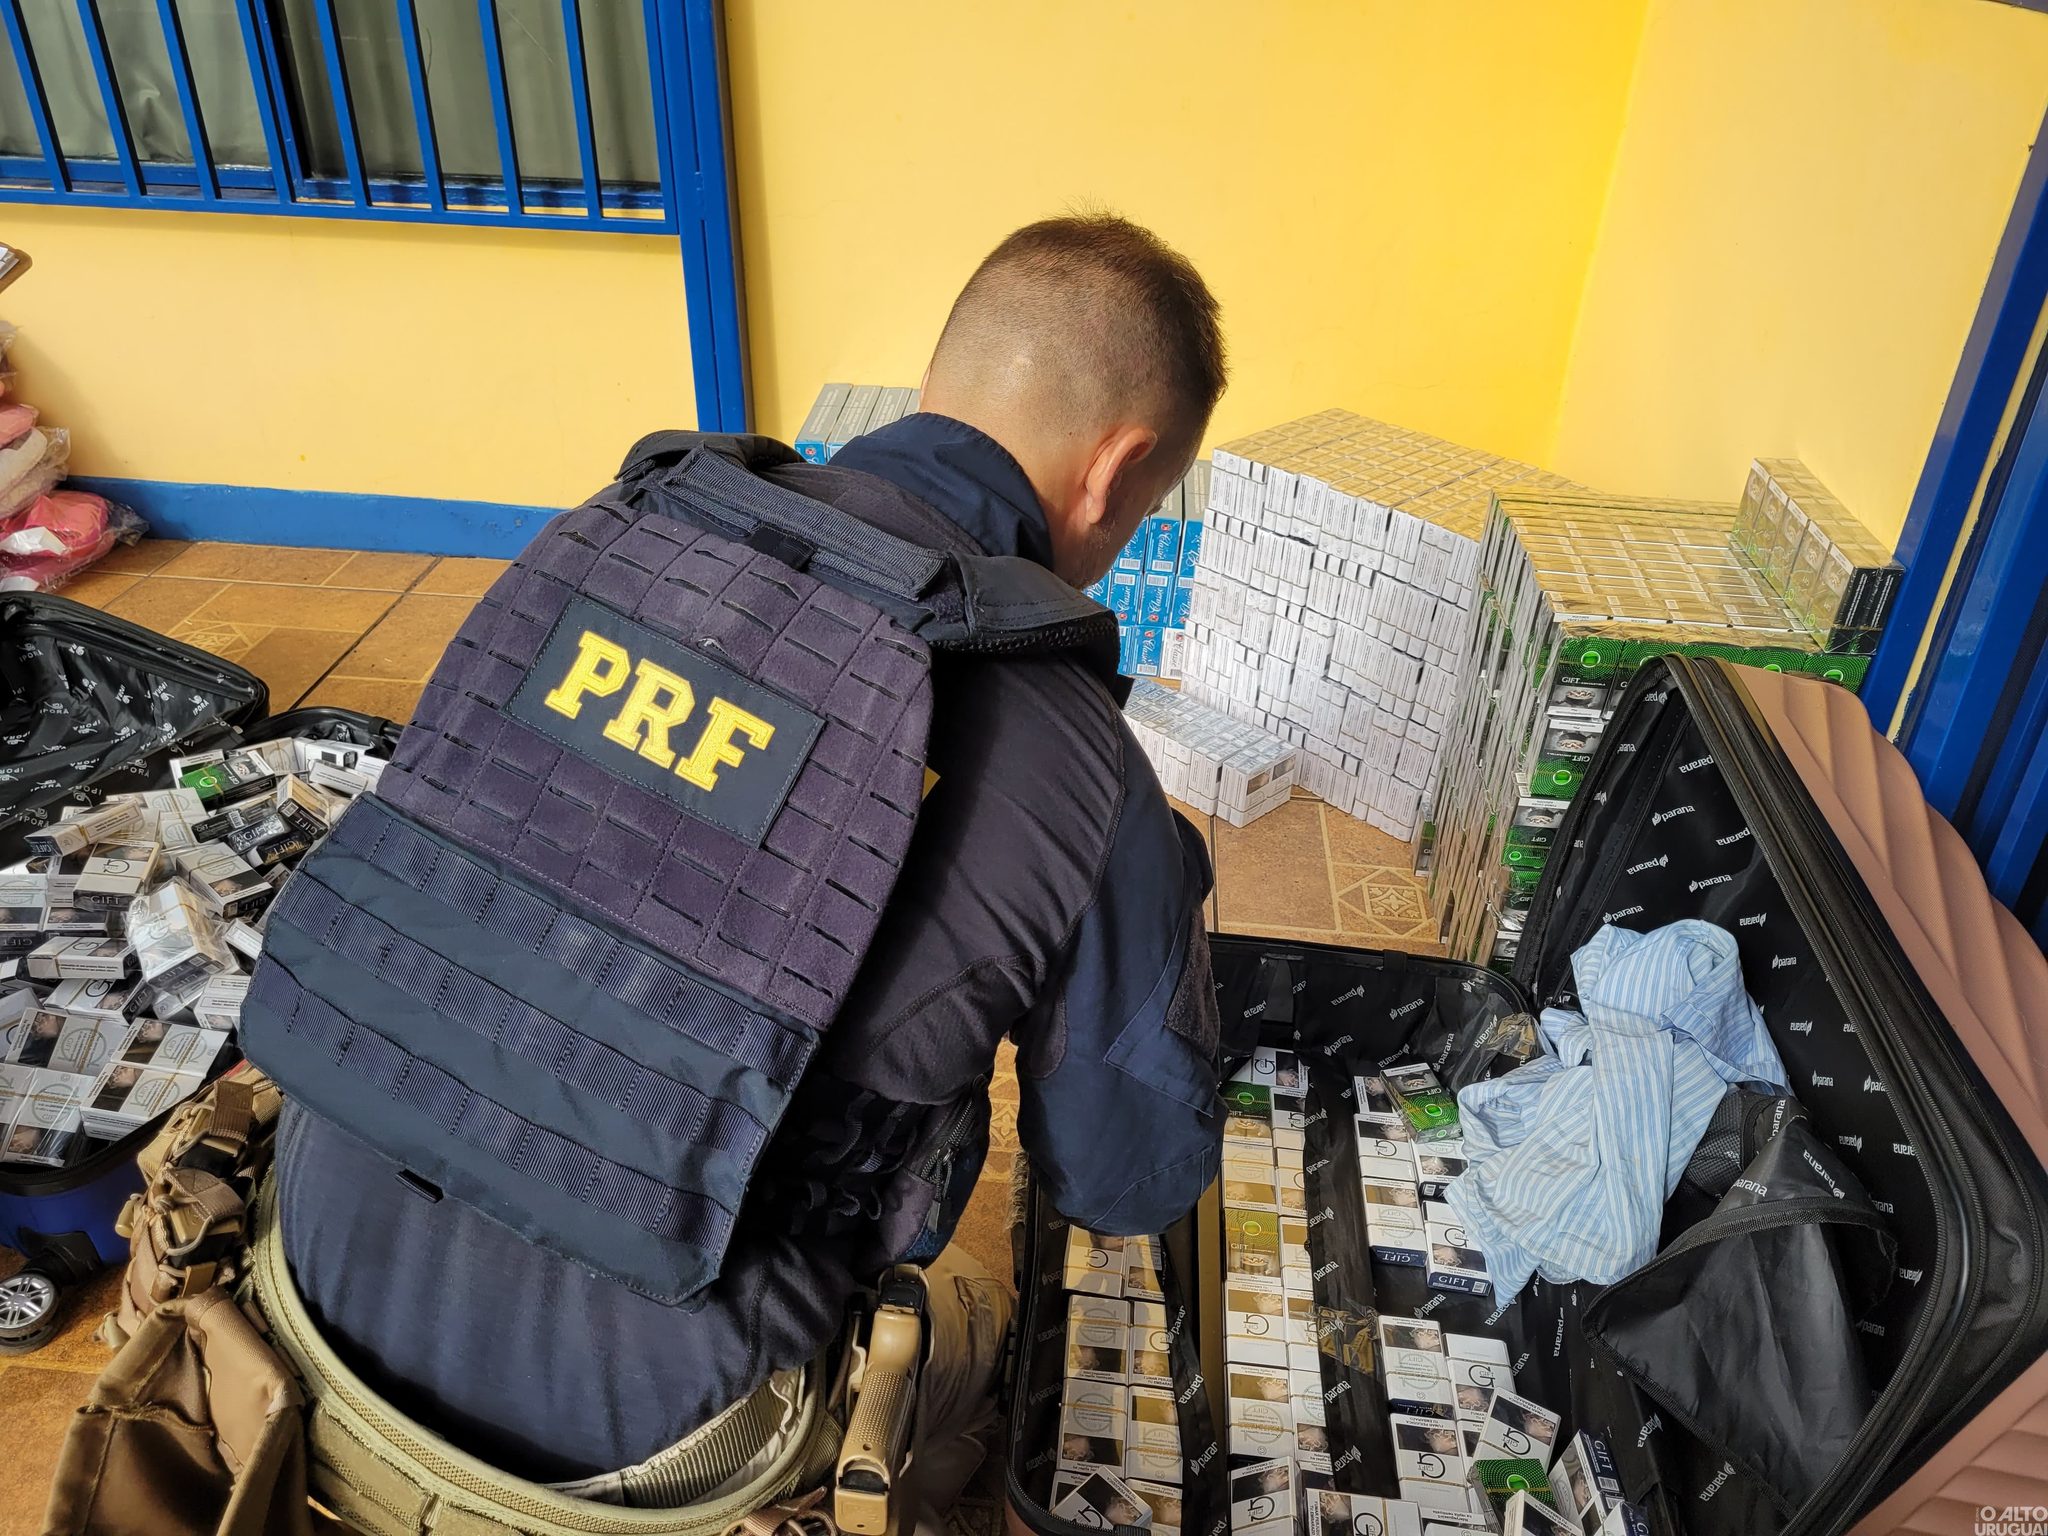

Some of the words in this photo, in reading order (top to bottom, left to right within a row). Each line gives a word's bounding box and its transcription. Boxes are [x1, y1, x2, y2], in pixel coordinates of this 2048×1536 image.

[1116, 586, 1131, 612] Classic
[1148, 587, 1163, 613] Classic
[1561, 676, 1580, 684] GIFT
[545, 631, 775, 791] PRF
[1572, 755, 1591, 763] GIFT
[1678, 754, 1714, 774] parana
[1661, 805, 1695, 822] parana
[296, 817, 318, 836] GIFT
[1716, 827, 1750, 846] parana
[273, 840, 299, 855] GIFT
[1626, 858, 1659, 875] parana
[1698, 874, 1732, 889] parana
[90, 895, 121, 905] GIFT
[1612, 905, 1644, 922] parana
[1739, 914, 1760, 926] parana
[3, 938, 33, 946] GIFT
[1777, 956, 1797, 969] parana
[129, 989, 149, 1014] GIFT
[1331, 988, 1357, 1006] parana
[1397, 998, 1425, 1016] parana
[1473, 1021, 1494, 1049] parana
[1790, 1021, 1808, 1032] parana
[1329, 1034, 1353, 1053] parana
[1438, 1033, 1455, 1065] parana
[1378, 1048, 1404, 1068] parana
[1816, 1075, 1834, 1087] parana
[1771, 1099, 1786, 1138] parana
[1838, 1135, 1858, 1149] parana
[1893, 1143, 1916, 1156] arana
[1803, 1149, 1836, 1189] parana
[1383, 1253, 1411, 1263] GIFT
[1313, 1260, 1340, 1281] parana
[1438, 1275, 1468, 1286] GIFT
[1421, 1293, 1446, 1316] parana
[1553, 1318, 1565, 1357] parana
[1178, 1374, 1204, 1404] parana
[1324, 1379, 1352, 1404] parana
[1594, 1440, 1613, 1471] GIFT
[1699, 1470, 1729, 1502] parana
